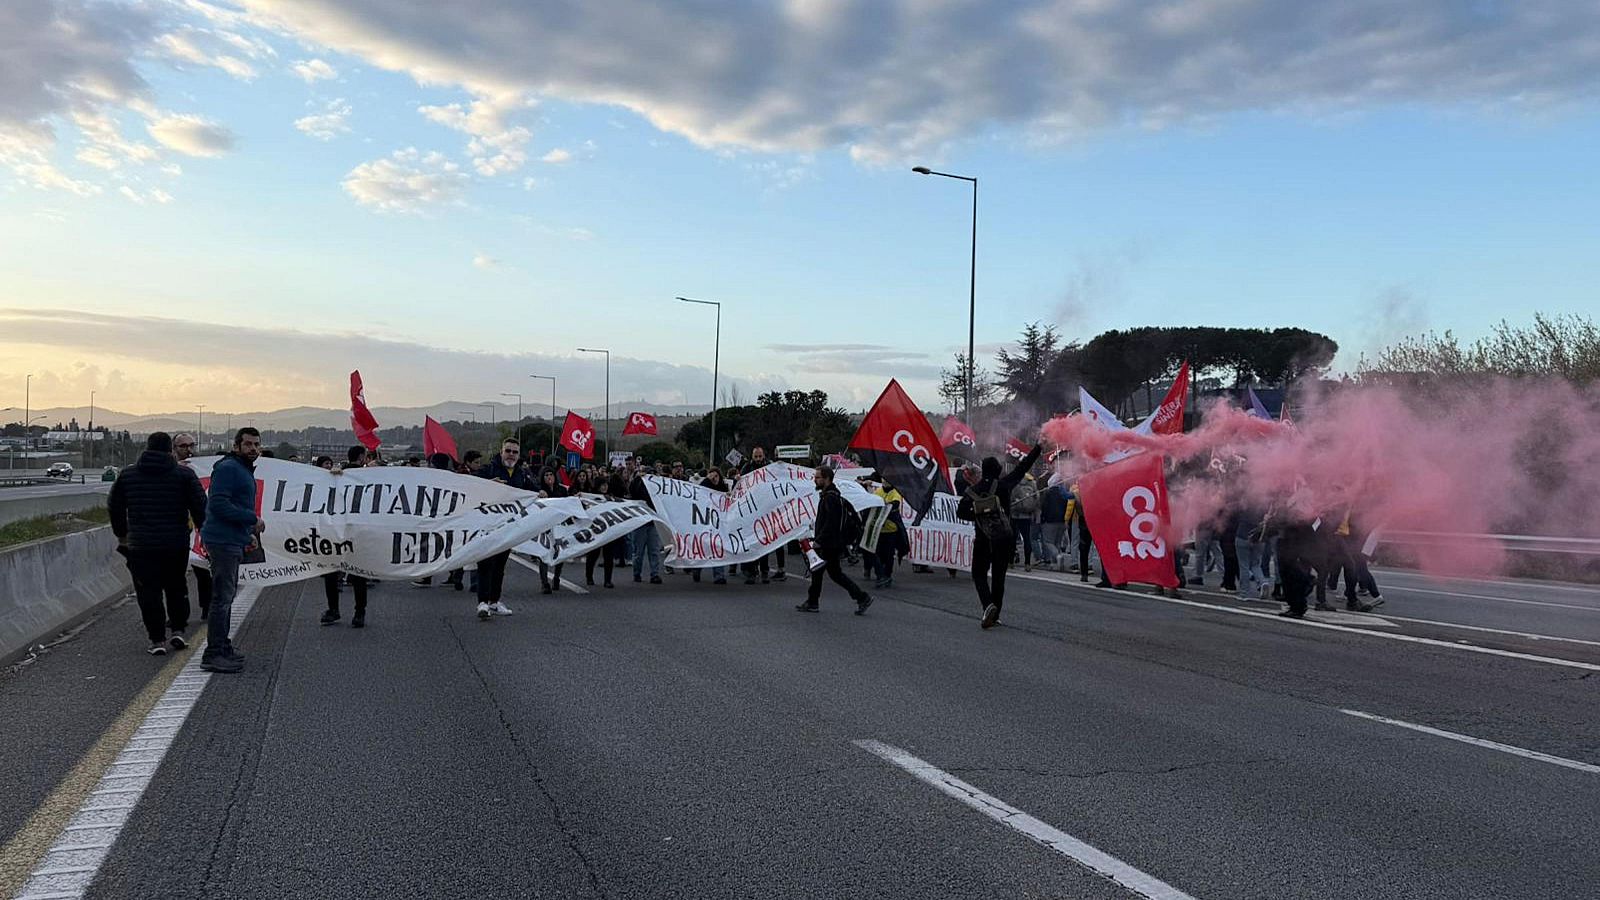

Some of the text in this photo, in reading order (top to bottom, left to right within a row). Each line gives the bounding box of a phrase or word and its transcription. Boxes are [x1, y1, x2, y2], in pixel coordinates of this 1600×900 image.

[272, 480, 465, 518] LLUITANT
[648, 475, 700, 501] SENSE
[691, 503, 720, 529] NO
[729, 527, 749, 555] DE
[754, 493, 818, 546] QUALITAT
[284, 527, 353, 556] estem
